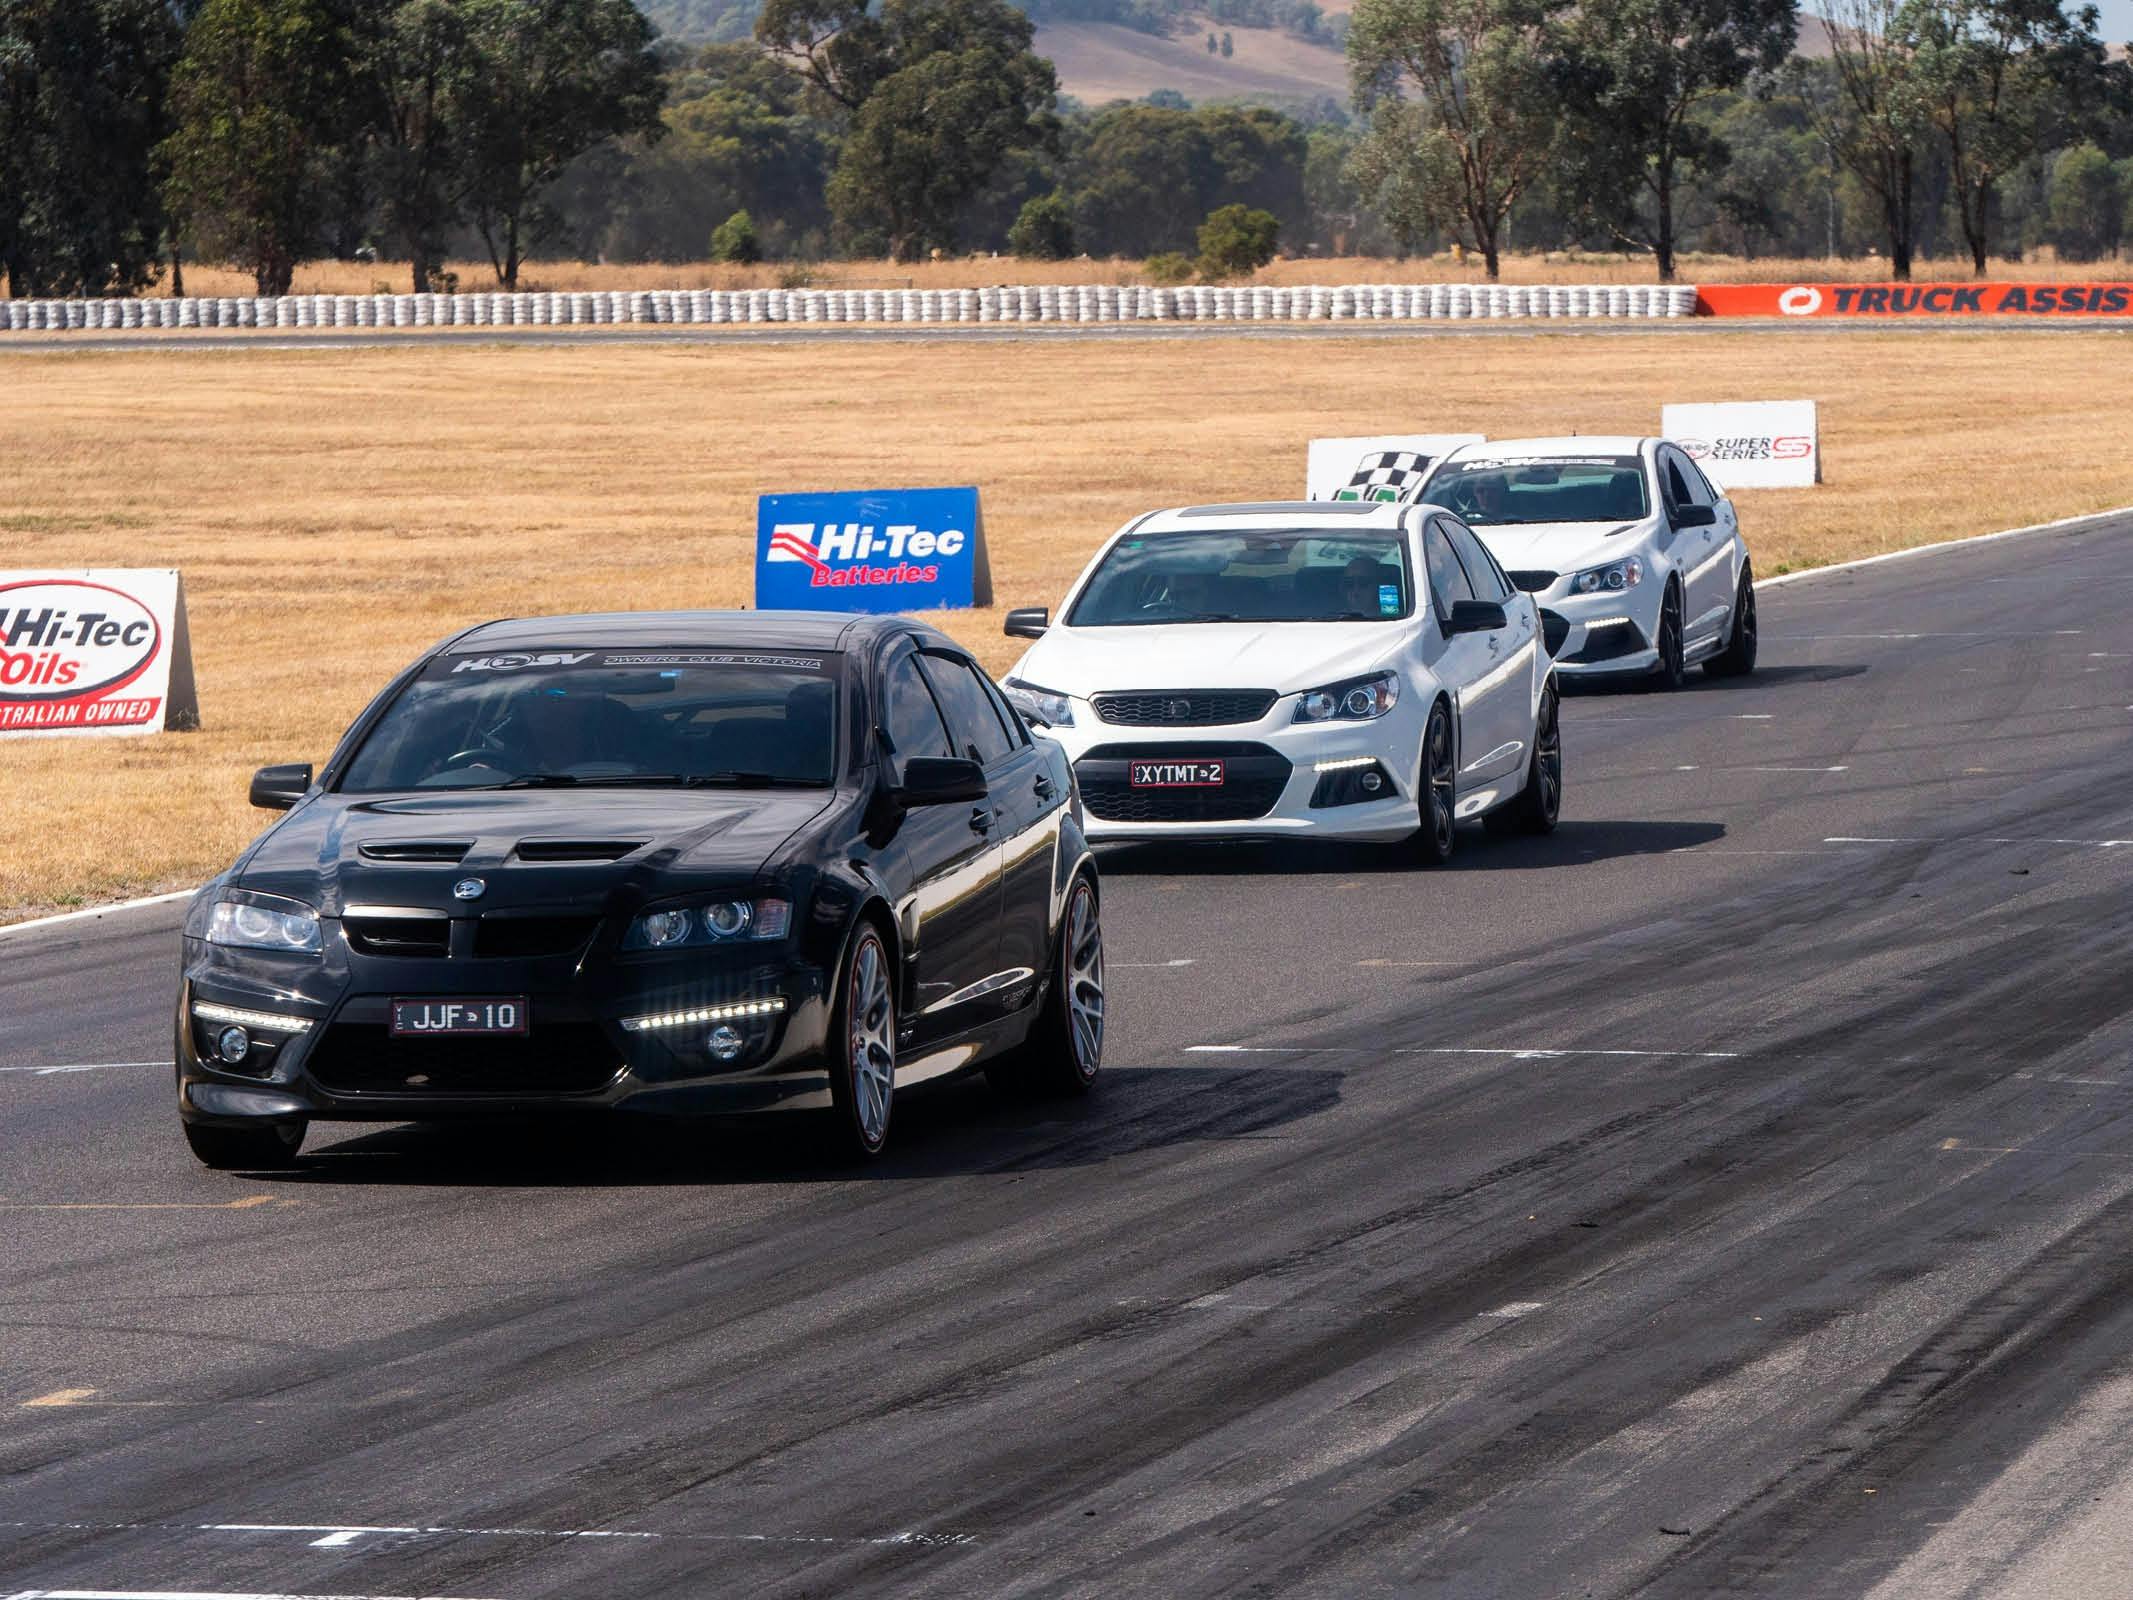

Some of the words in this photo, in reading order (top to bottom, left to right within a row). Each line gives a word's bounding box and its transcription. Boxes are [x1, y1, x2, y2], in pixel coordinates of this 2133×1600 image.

[1833, 287, 1988, 313] TRUCK
[1997, 286, 2133, 313] ASSIS
[1711, 449, 1770, 460] SERIES
[1714, 437, 1772, 450] SUPER
[816, 522, 965, 561] Hi-Tec
[810, 561, 939, 587] Batteries
[4, 607, 150, 647] Hi-Tec
[1, 652, 81, 685] Oils
[604, 655, 681, 664] OWNERS
[688, 655, 736, 663] CLUB
[743, 656, 823, 668] VICTORIA
[0, 704, 82, 725] TRALIAN
[84, 701, 151, 721] OWNED
[1141, 765, 1198, 782] XYTMT
[413, 1004, 464, 1029] JJF
[486, 1003, 516, 1029] 10
